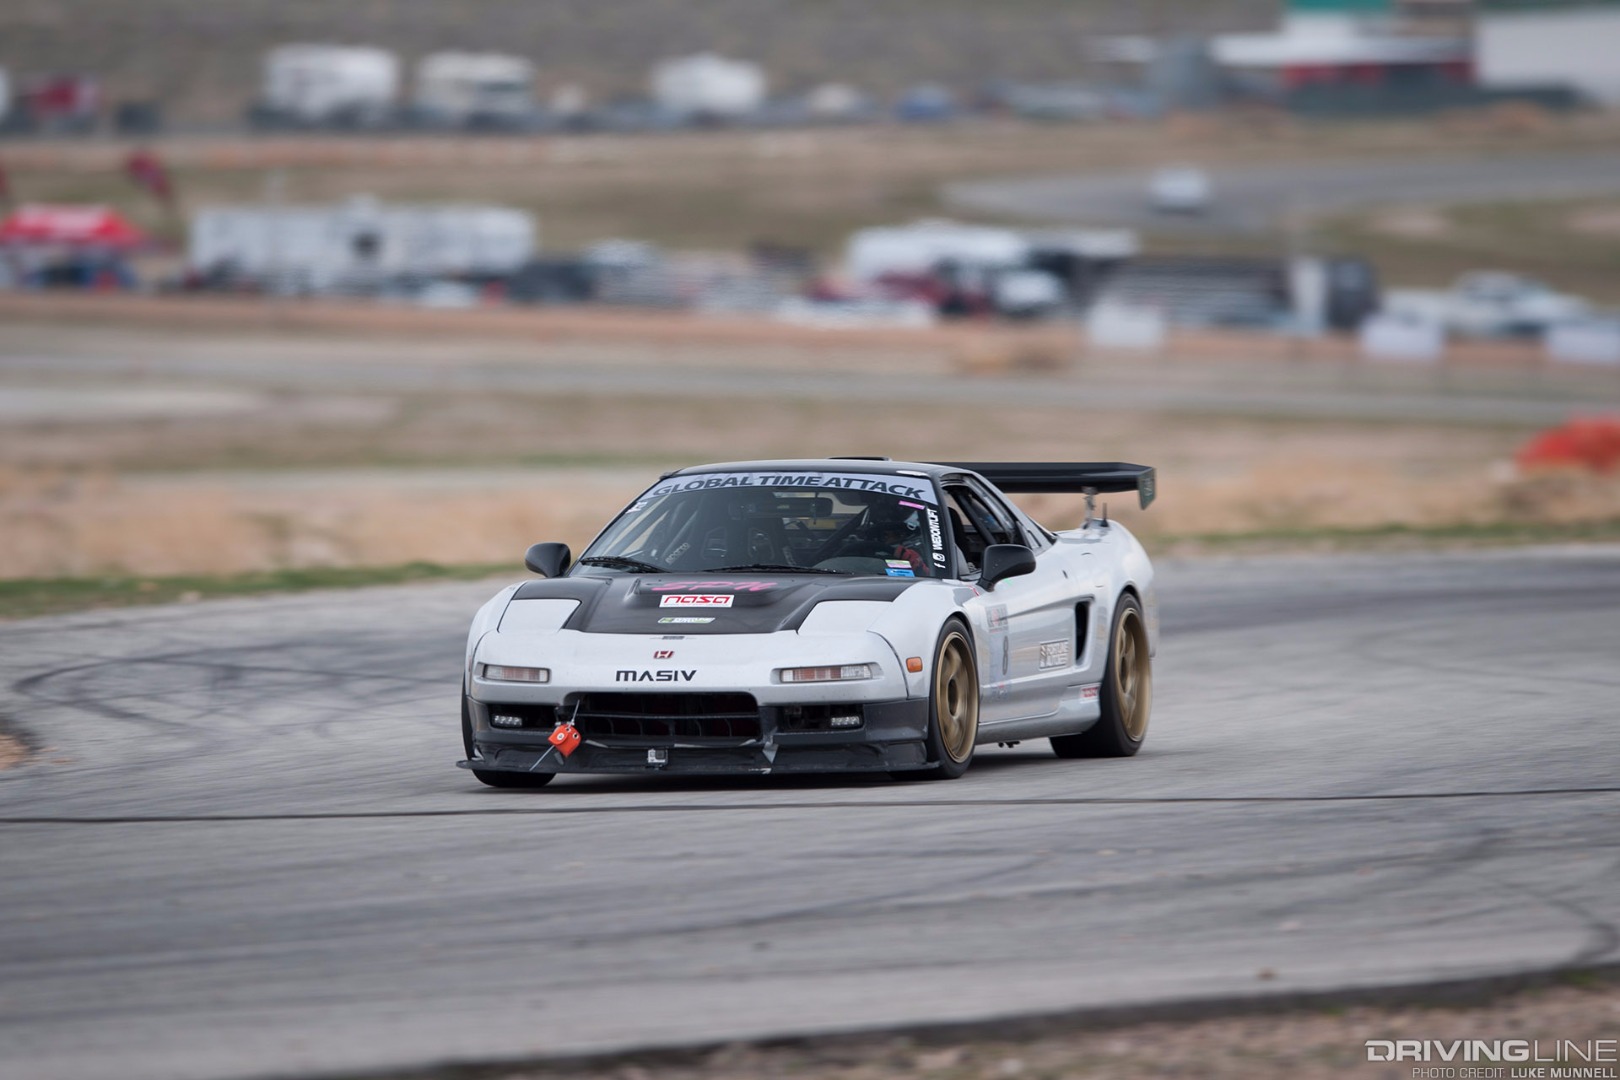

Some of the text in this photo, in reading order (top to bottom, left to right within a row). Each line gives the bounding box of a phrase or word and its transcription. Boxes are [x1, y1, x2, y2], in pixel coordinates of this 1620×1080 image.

[653, 475, 925, 499] GLOBAL TIME ATTACK
[615, 669, 697, 682] MASIV
